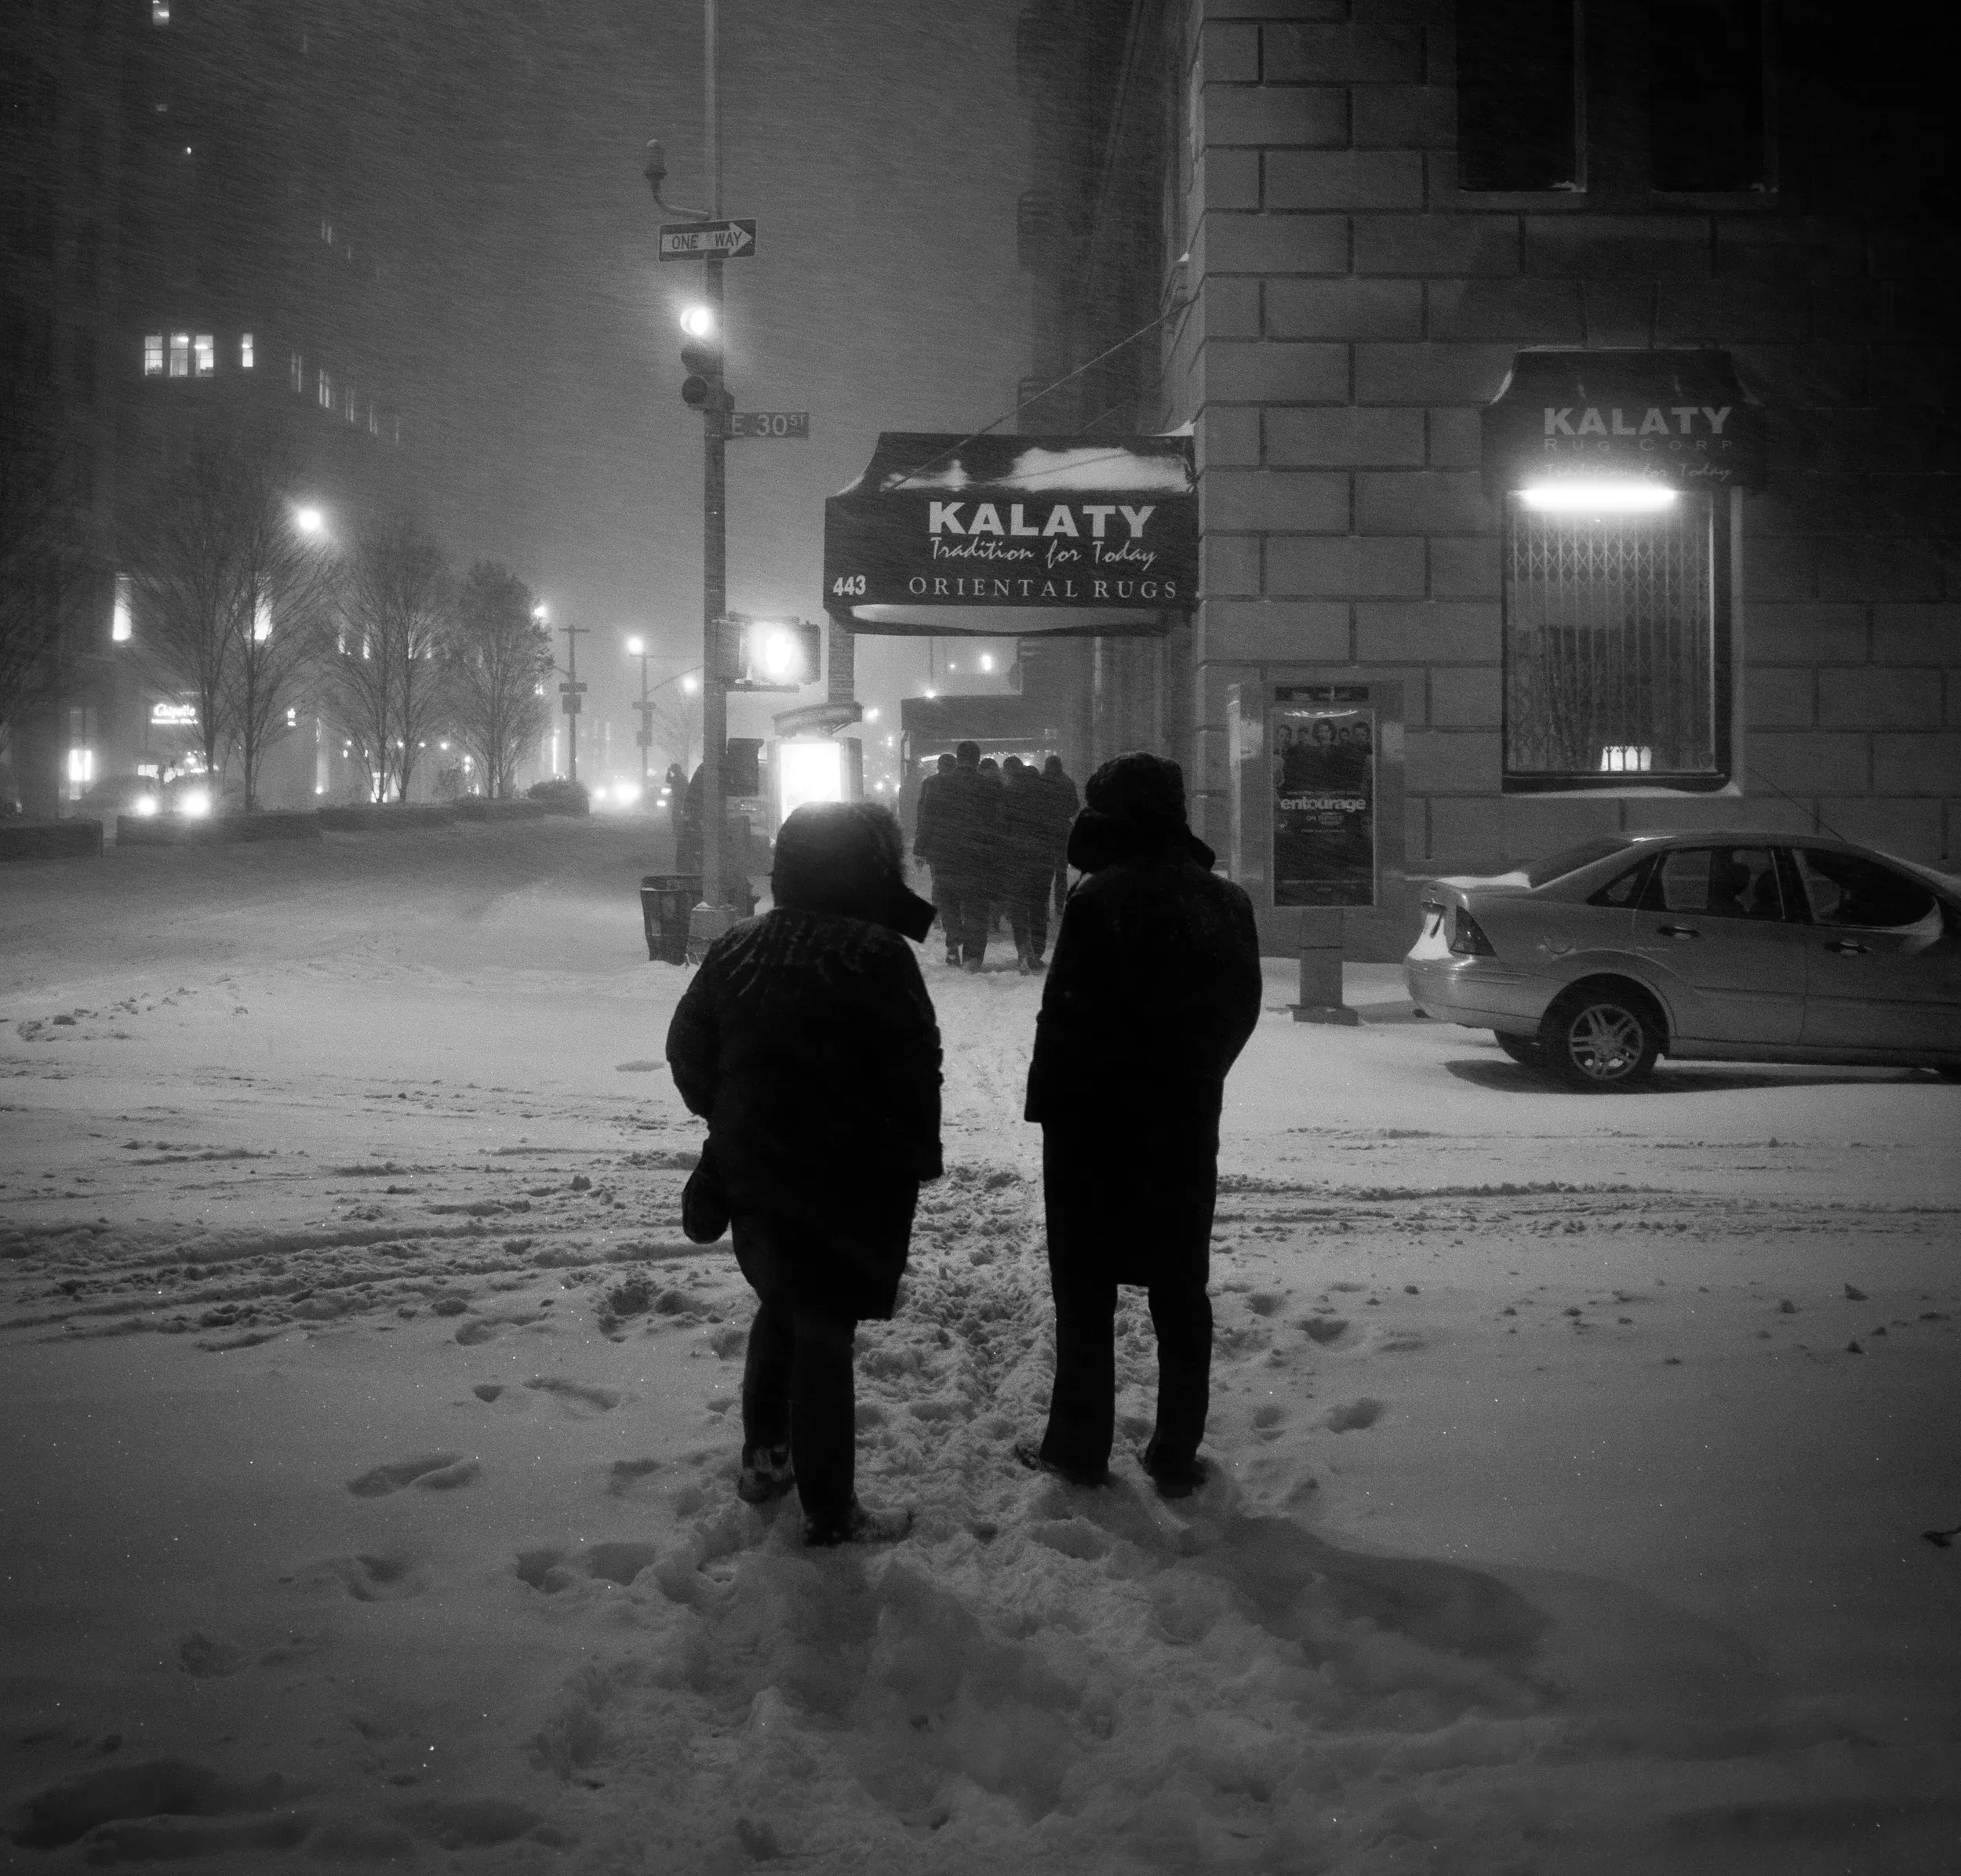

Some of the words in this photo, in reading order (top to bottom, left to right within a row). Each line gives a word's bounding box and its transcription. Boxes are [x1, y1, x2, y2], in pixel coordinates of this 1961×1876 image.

[671, 234, 699, 249] ONE
[715, 231, 742, 248] WAY
[732, 414, 745, 436] E
[1544, 406, 1732, 435] KALATY
[1544, 438, 1610, 452] RUG
[1639, 438, 1732, 452] CORP
[929, 501, 1155, 538] KALATY
[930, 536, 1035, 560] Tradition
[1046, 540, 1082, 569] for
[1093, 541, 1158, 571] Today
[832, 575, 866, 596] 443
[908, 576, 1079, 598] ORIENTAL
[1093, 580, 1177, 599] RUGS
[1281, 796, 1366, 813] entourage
